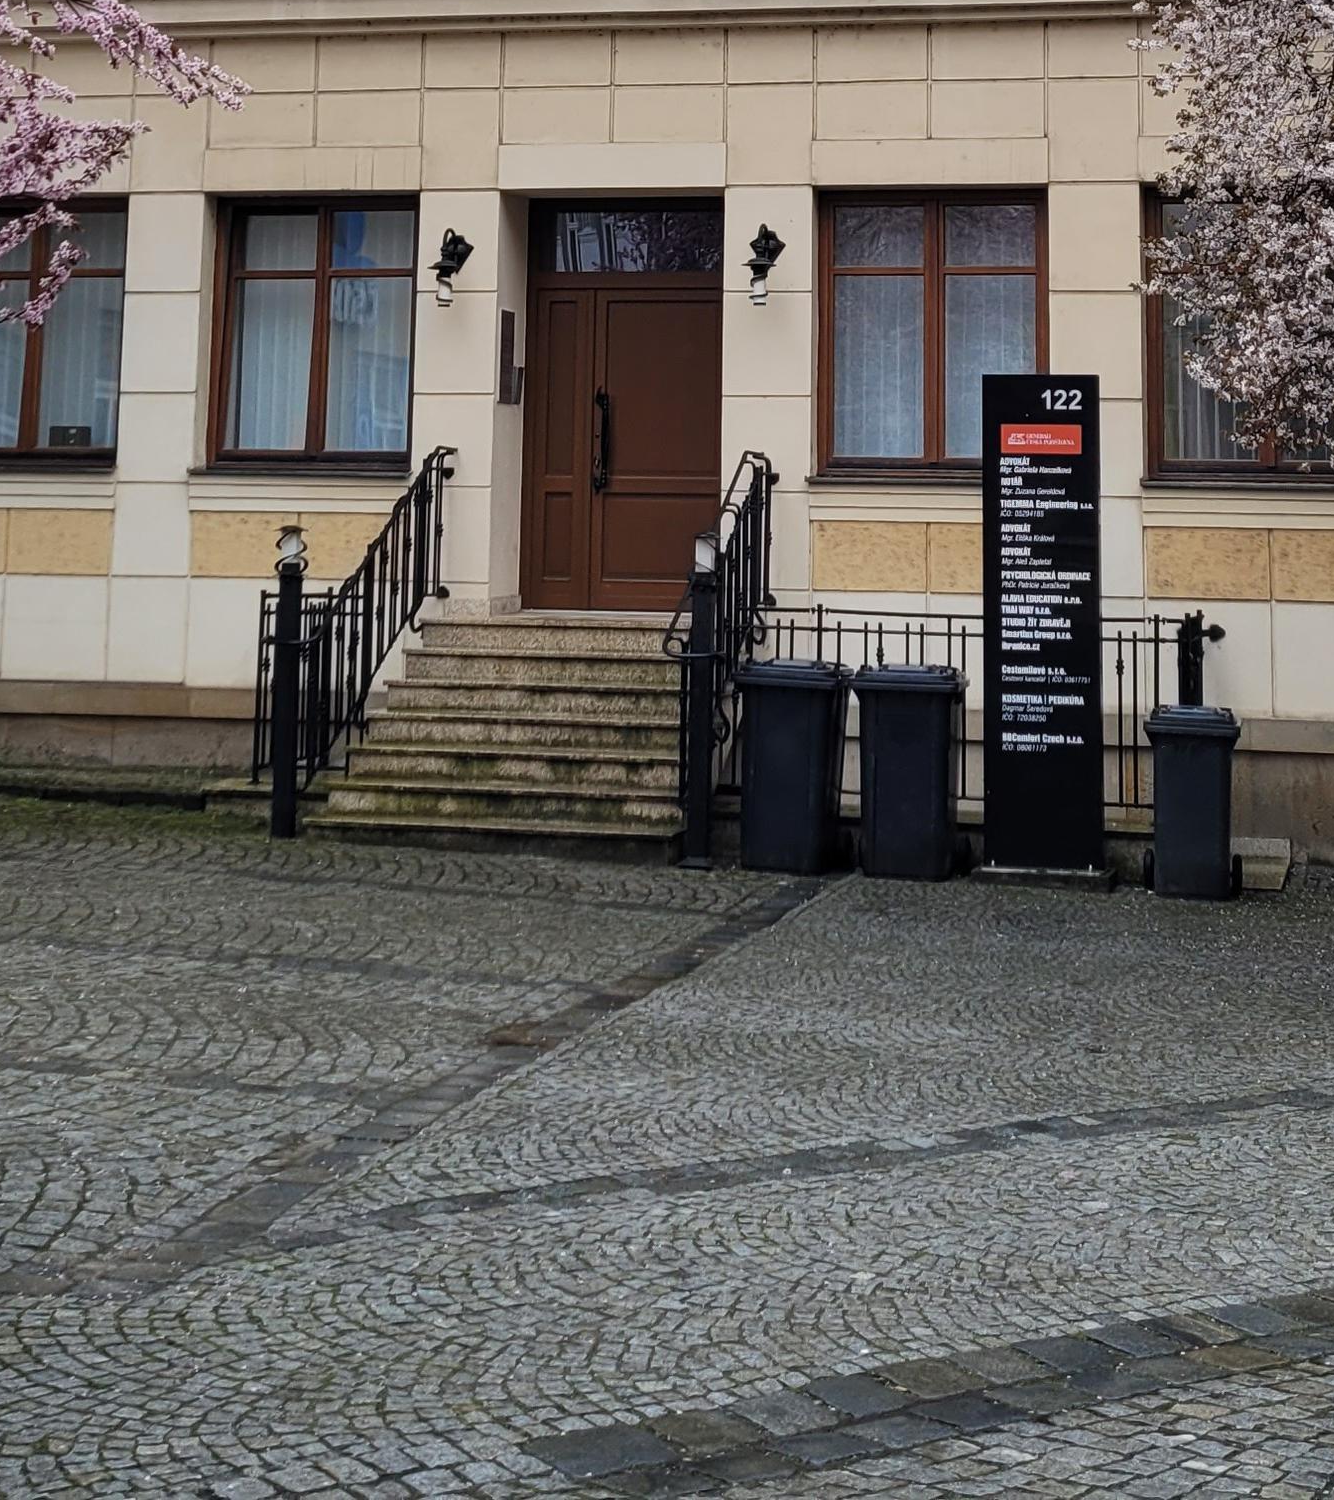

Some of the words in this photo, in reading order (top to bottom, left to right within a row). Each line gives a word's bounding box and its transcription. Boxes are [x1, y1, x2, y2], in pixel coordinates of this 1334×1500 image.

[1041, 389, 1082, 411] 122
[1000, 456, 1030, 466] ADVOKÁT
[1035, 499, 1078, 510] Engineering
[1001, 523, 1031, 532] ADVOKÁT
[1001, 546, 1031, 556] ADVOKÁT
[1001, 570, 1056, 580] PSYCHOLOGICKÁ
[1057, 572, 1091, 581] ORDINACE
[1025, 594, 1063, 604] EDUCATION
[1001, 605, 1018, 614] THAI
[1018, 605, 1034, 614] WAY
[1001, 617, 1026, 626] STUDIO
[1034, 629, 1056, 640] Group
[1002, 693, 1043, 704] KOSMETIKA
[1002, 704, 1024, 713] Dagmar
[1042, 733, 1065, 743] Czech
